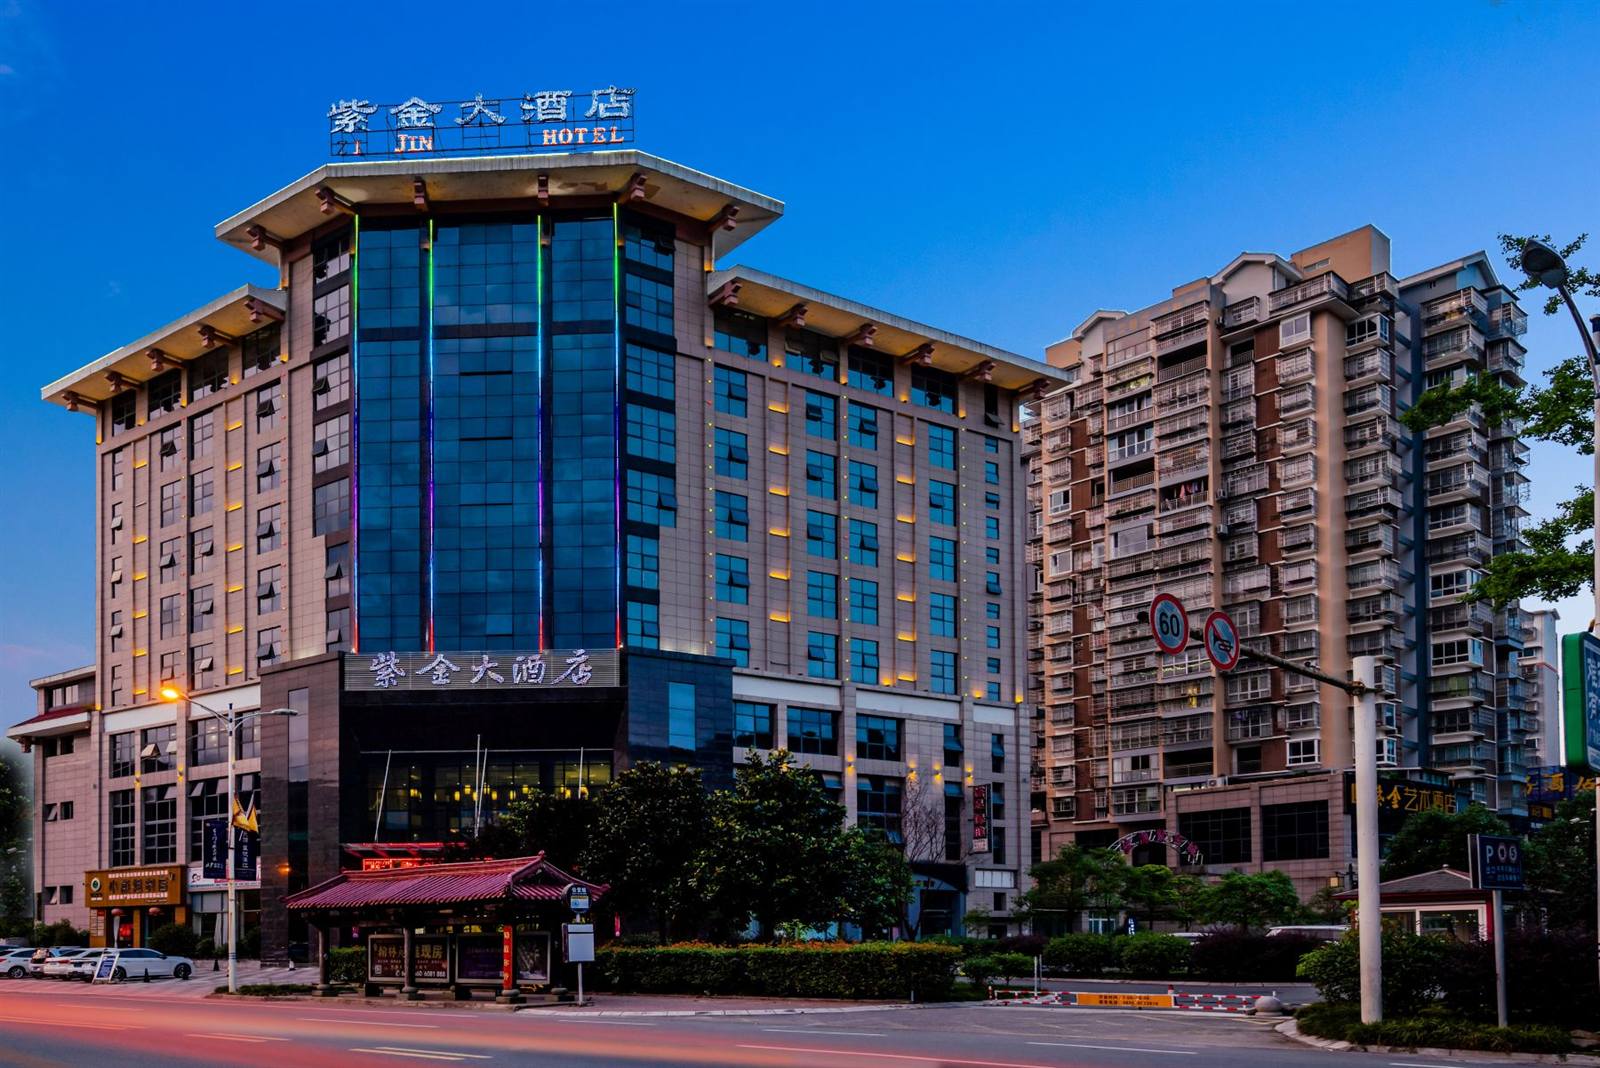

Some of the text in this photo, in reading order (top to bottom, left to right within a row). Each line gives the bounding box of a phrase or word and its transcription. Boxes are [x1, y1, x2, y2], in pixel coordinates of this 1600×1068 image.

[327, 84, 637, 134] 紫金大酒店
[394, 134, 434, 153] JIN
[542, 126, 624, 146] HOTEL
[1159, 611, 1180, 638] 60
[370, 648, 593, 688] 紫金大酒店
[1485, 844, 1494, 864] P
